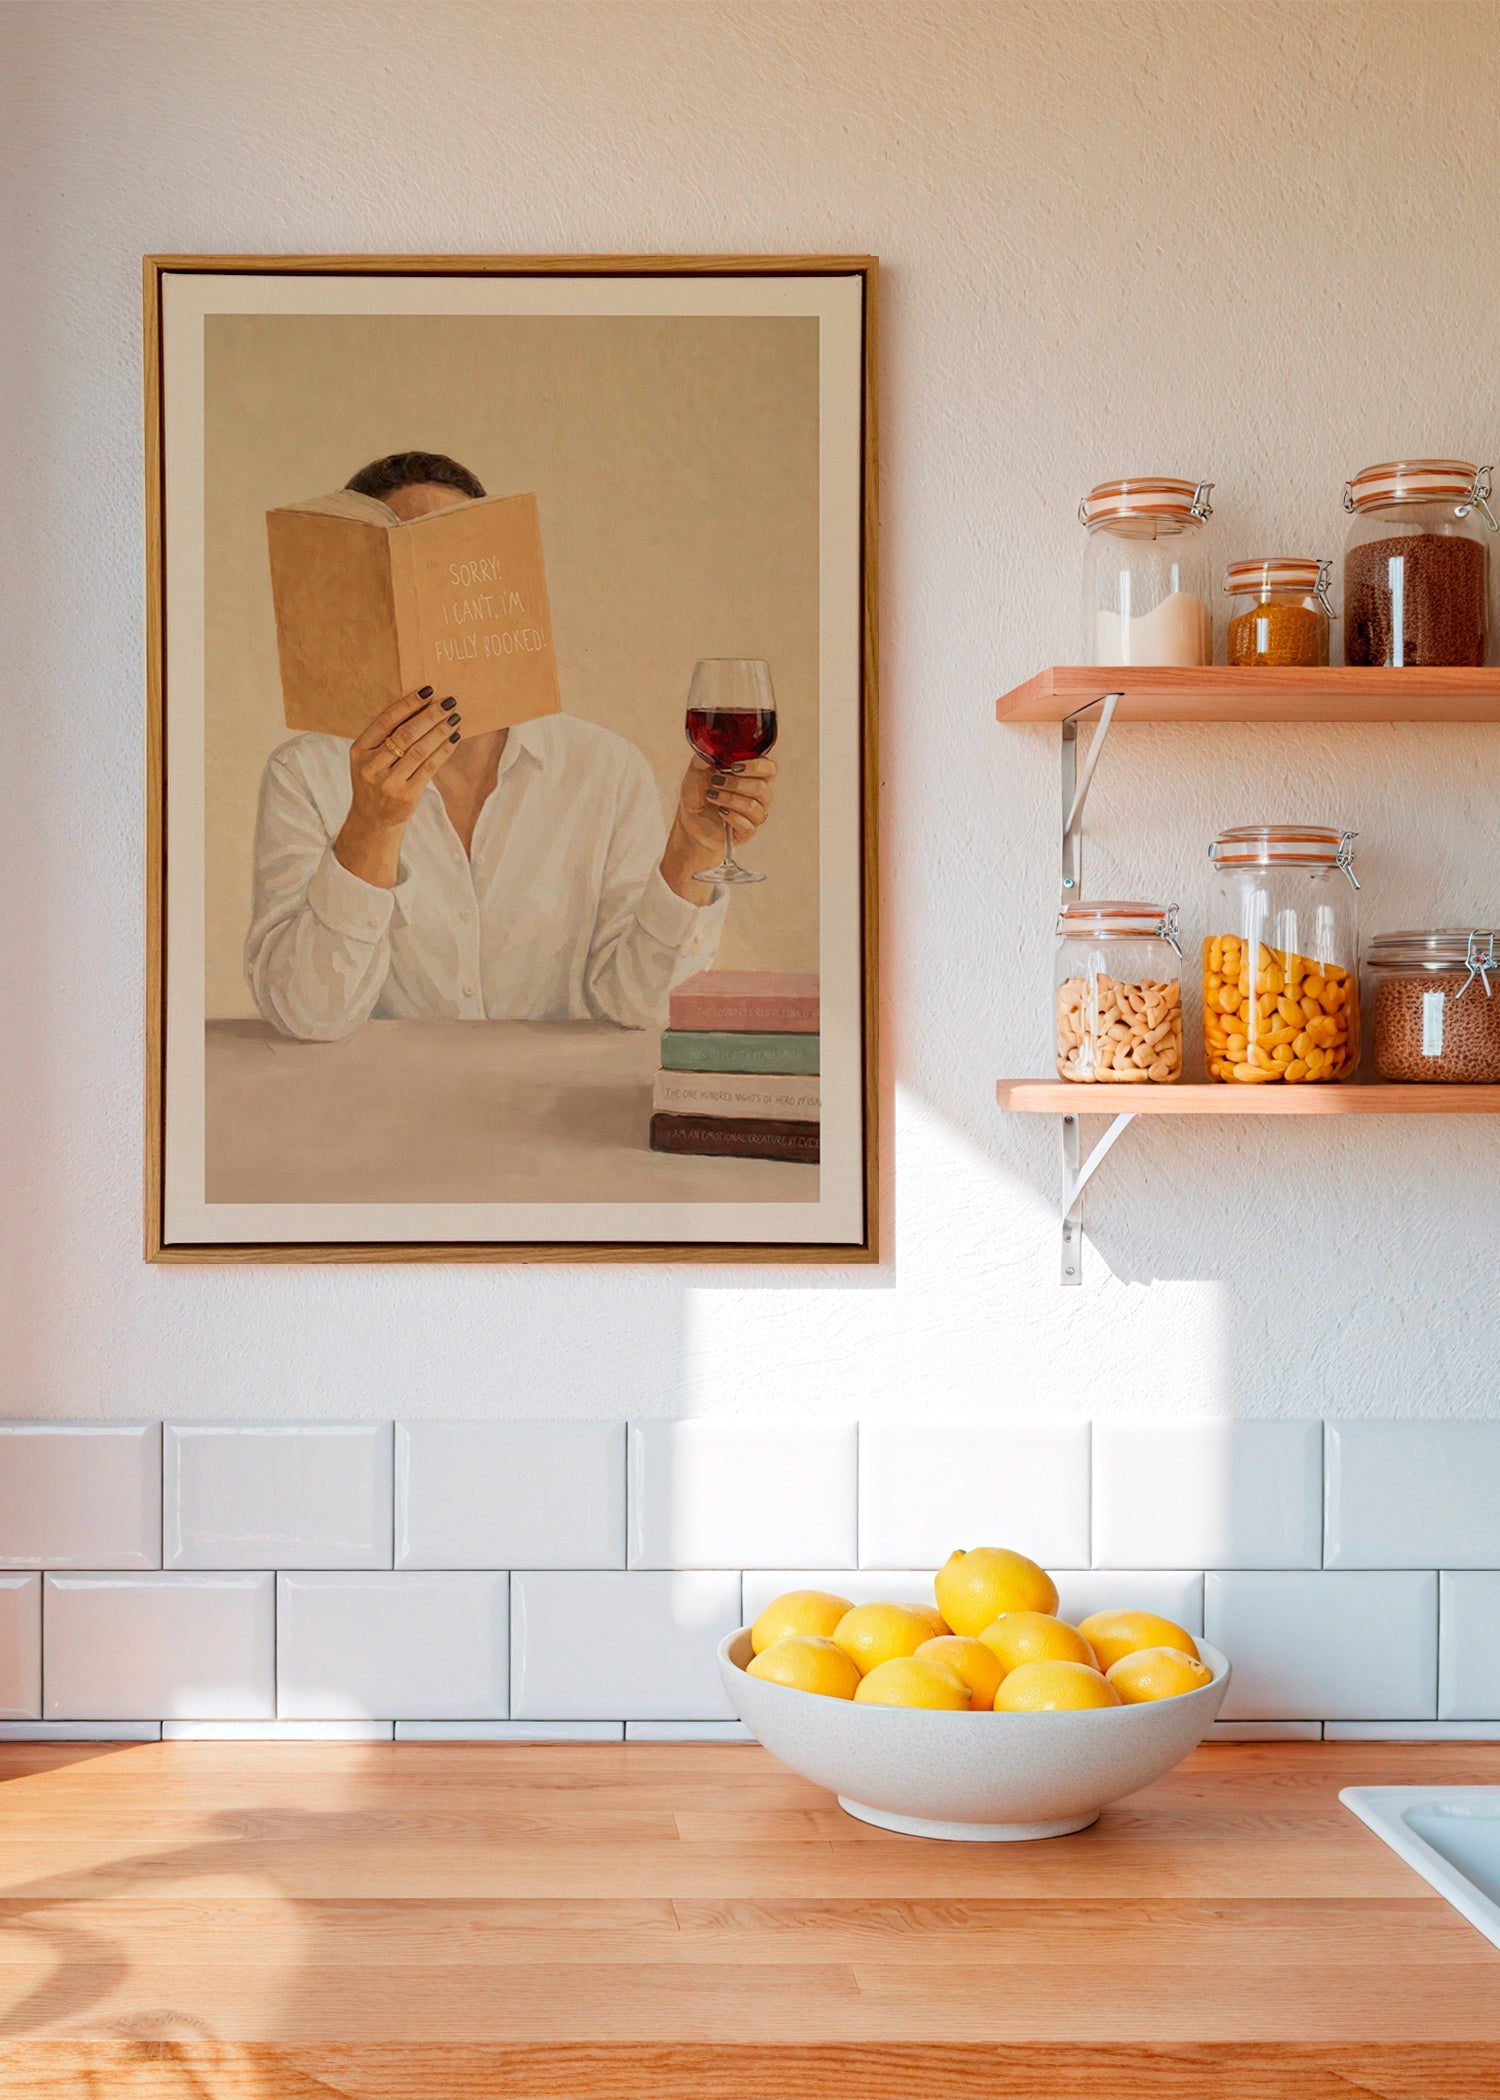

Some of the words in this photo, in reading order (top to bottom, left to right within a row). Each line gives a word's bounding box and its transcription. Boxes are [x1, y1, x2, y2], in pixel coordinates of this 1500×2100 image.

[449, 555, 502, 587] SORRY!
[442, 603, 449, 625] I
[501, 590, 525, 616] I'M
[435, 633, 478, 664] FULLY
[483, 628, 547, 658] BOOKED!
[665, 1088, 681, 1099] THE
[682, 1089, 698, 1100] ONE
[700, 1091, 733, 1101] HUNDRED
[734, 1093, 761, 1103] NIGHTS
[775, 1095, 795, 1106] HERO
[701, 1130, 746, 1143] EMOTIONAL
[748, 1133, 786, 1146] CREATURE
